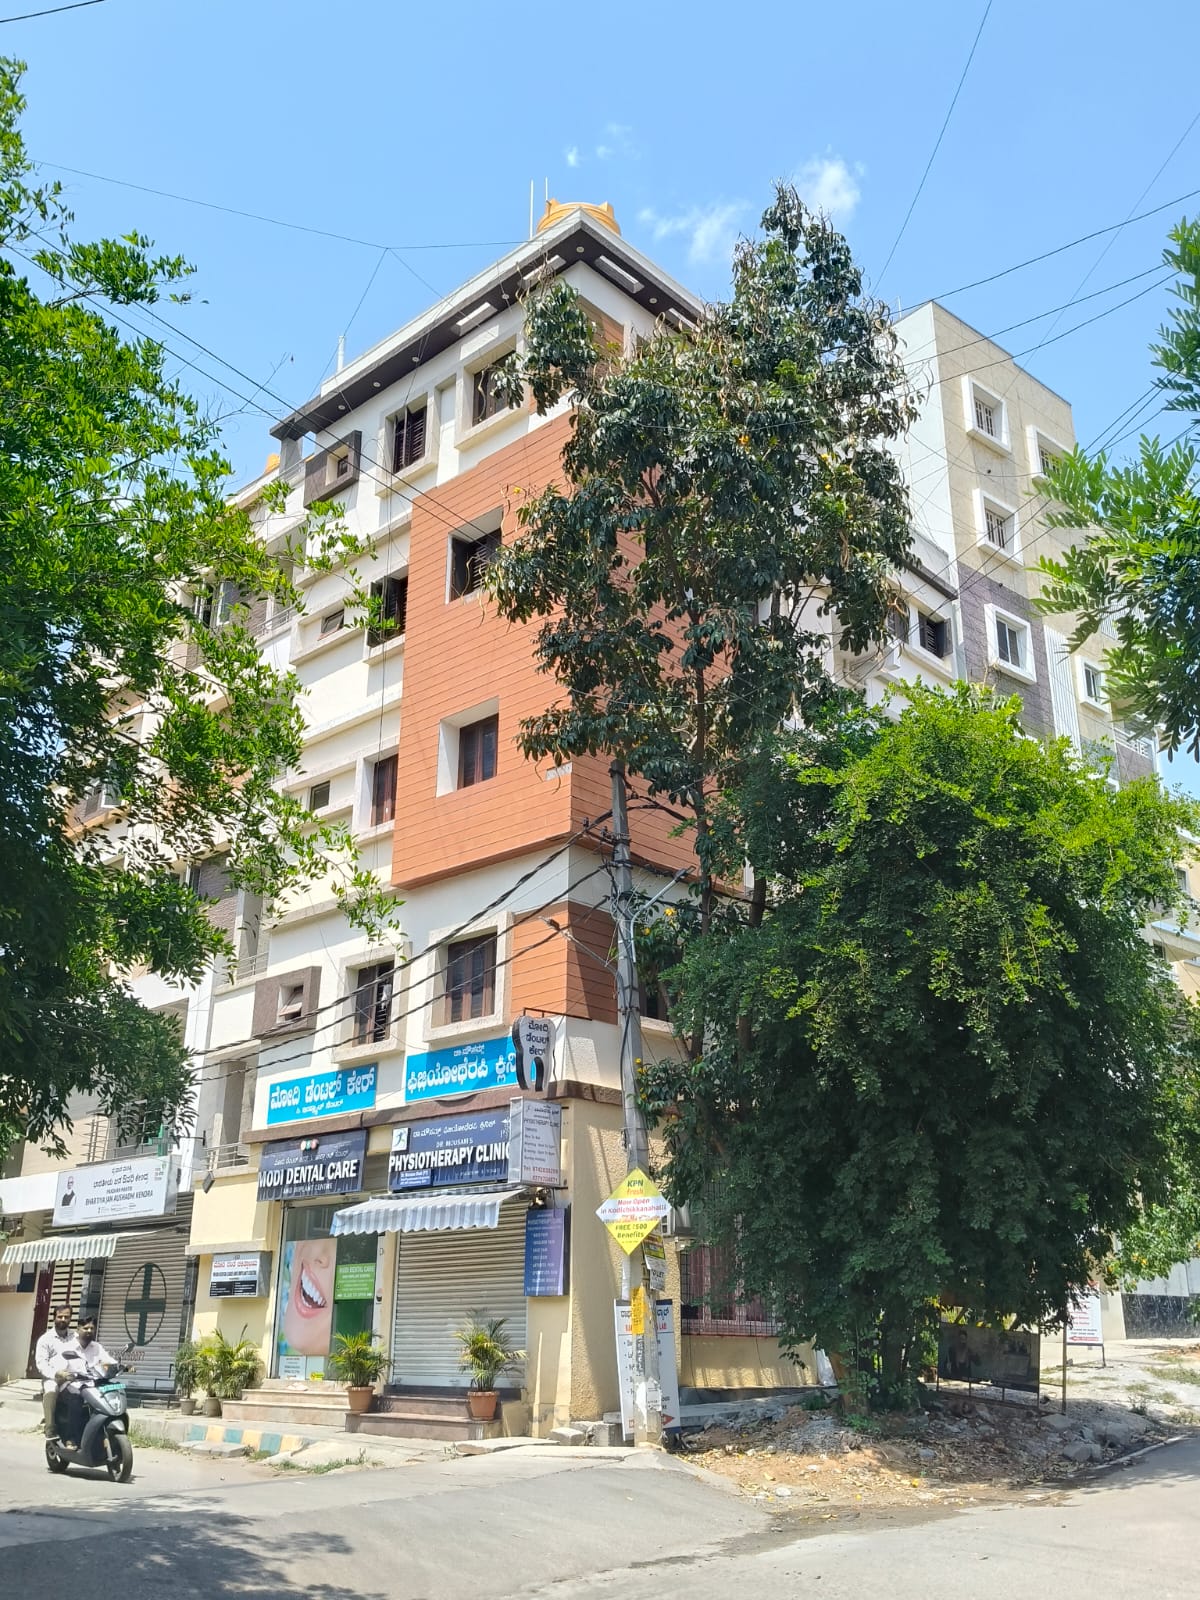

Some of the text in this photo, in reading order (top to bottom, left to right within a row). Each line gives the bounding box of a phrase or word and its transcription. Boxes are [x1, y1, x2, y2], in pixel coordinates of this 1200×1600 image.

[270, 1066, 375, 1110] ಮೋದಿ ಡೆಂಟಲ್ ಕೇರ್
[388, 1146, 474, 1173] PHYSIOTHERAPY
[259, 1159, 358, 1188] MODI DENTAL CARE
[135, 1190, 154, 1199] KENDRA
[617, 1231, 644, 1239] Benefits
